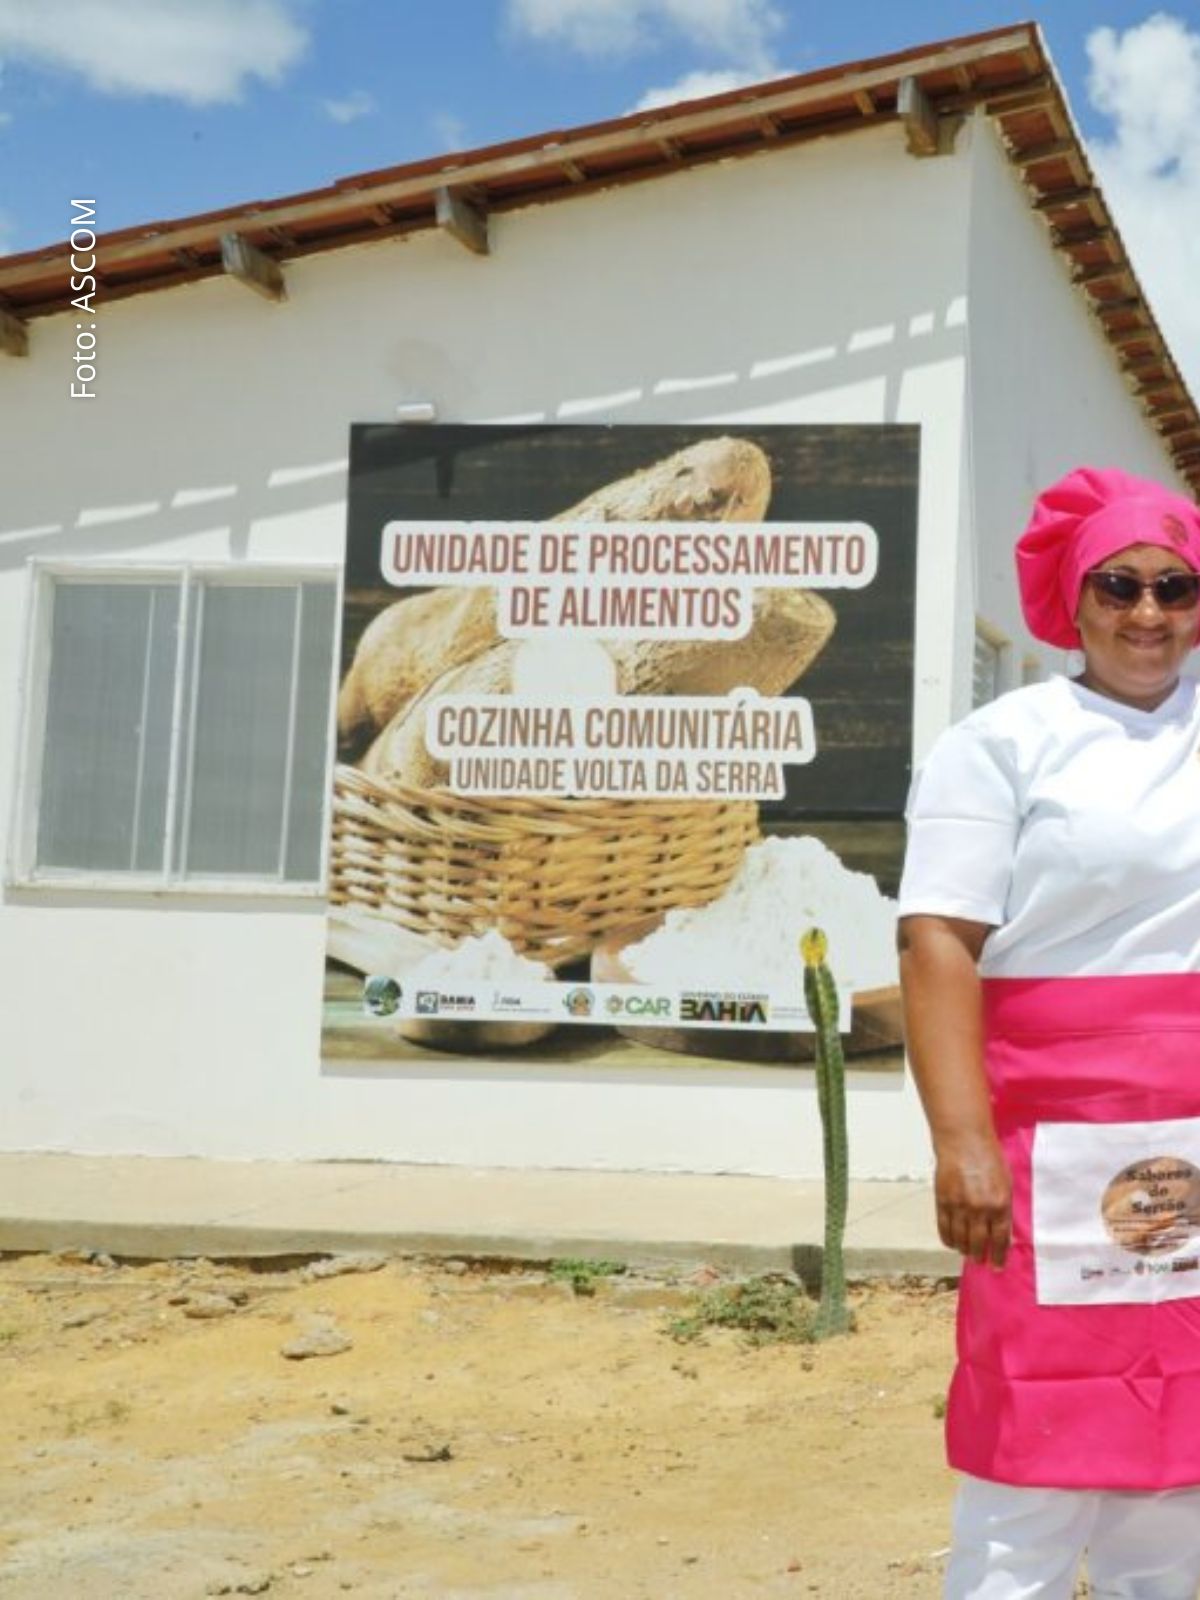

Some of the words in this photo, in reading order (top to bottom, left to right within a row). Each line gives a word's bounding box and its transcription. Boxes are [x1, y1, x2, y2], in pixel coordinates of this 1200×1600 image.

[393, 533, 528, 574] UNIDADE
[541, 535, 575, 574] DE
[590, 534, 865, 576] PROCESSAMENTO
[510, 587, 547, 626] DE
[559, 588, 741, 628] ALIMENTOS
[437, 706, 574, 748] COZINHA
[585, 700, 802, 750] COMUNITÁRIA
[457, 759, 565, 791] UNIDADE
[574, 760, 647, 792] VOLTA
[656, 761, 688, 792] DA
[697, 762, 779, 794] SERRA
[625, 996, 671, 1015] CAR
[680, 999, 768, 1023] BAHIA
